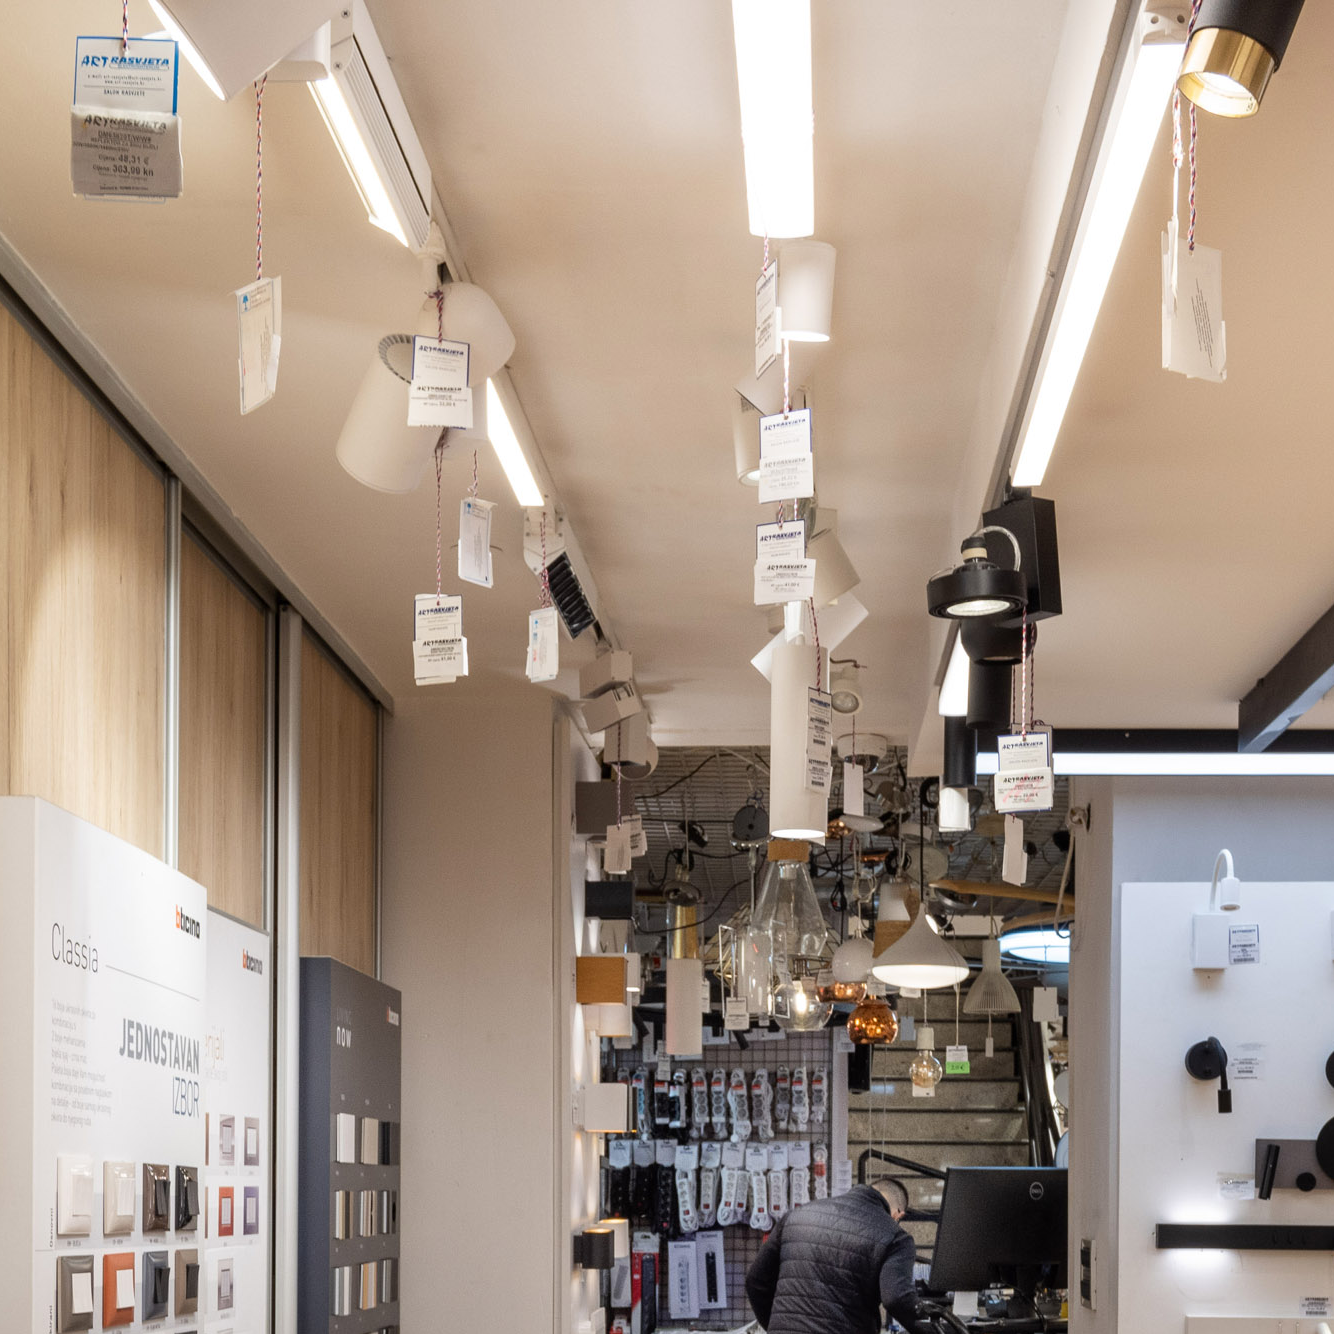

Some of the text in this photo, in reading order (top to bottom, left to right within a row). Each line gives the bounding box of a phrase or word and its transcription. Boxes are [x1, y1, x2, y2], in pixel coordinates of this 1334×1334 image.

[176, 904, 200, 940] bticino
[51, 922, 99, 973] Classia
[119, 1017, 199, 1075] JEDNOSTAVAN
[172, 1077, 199, 1118] IZBOR
